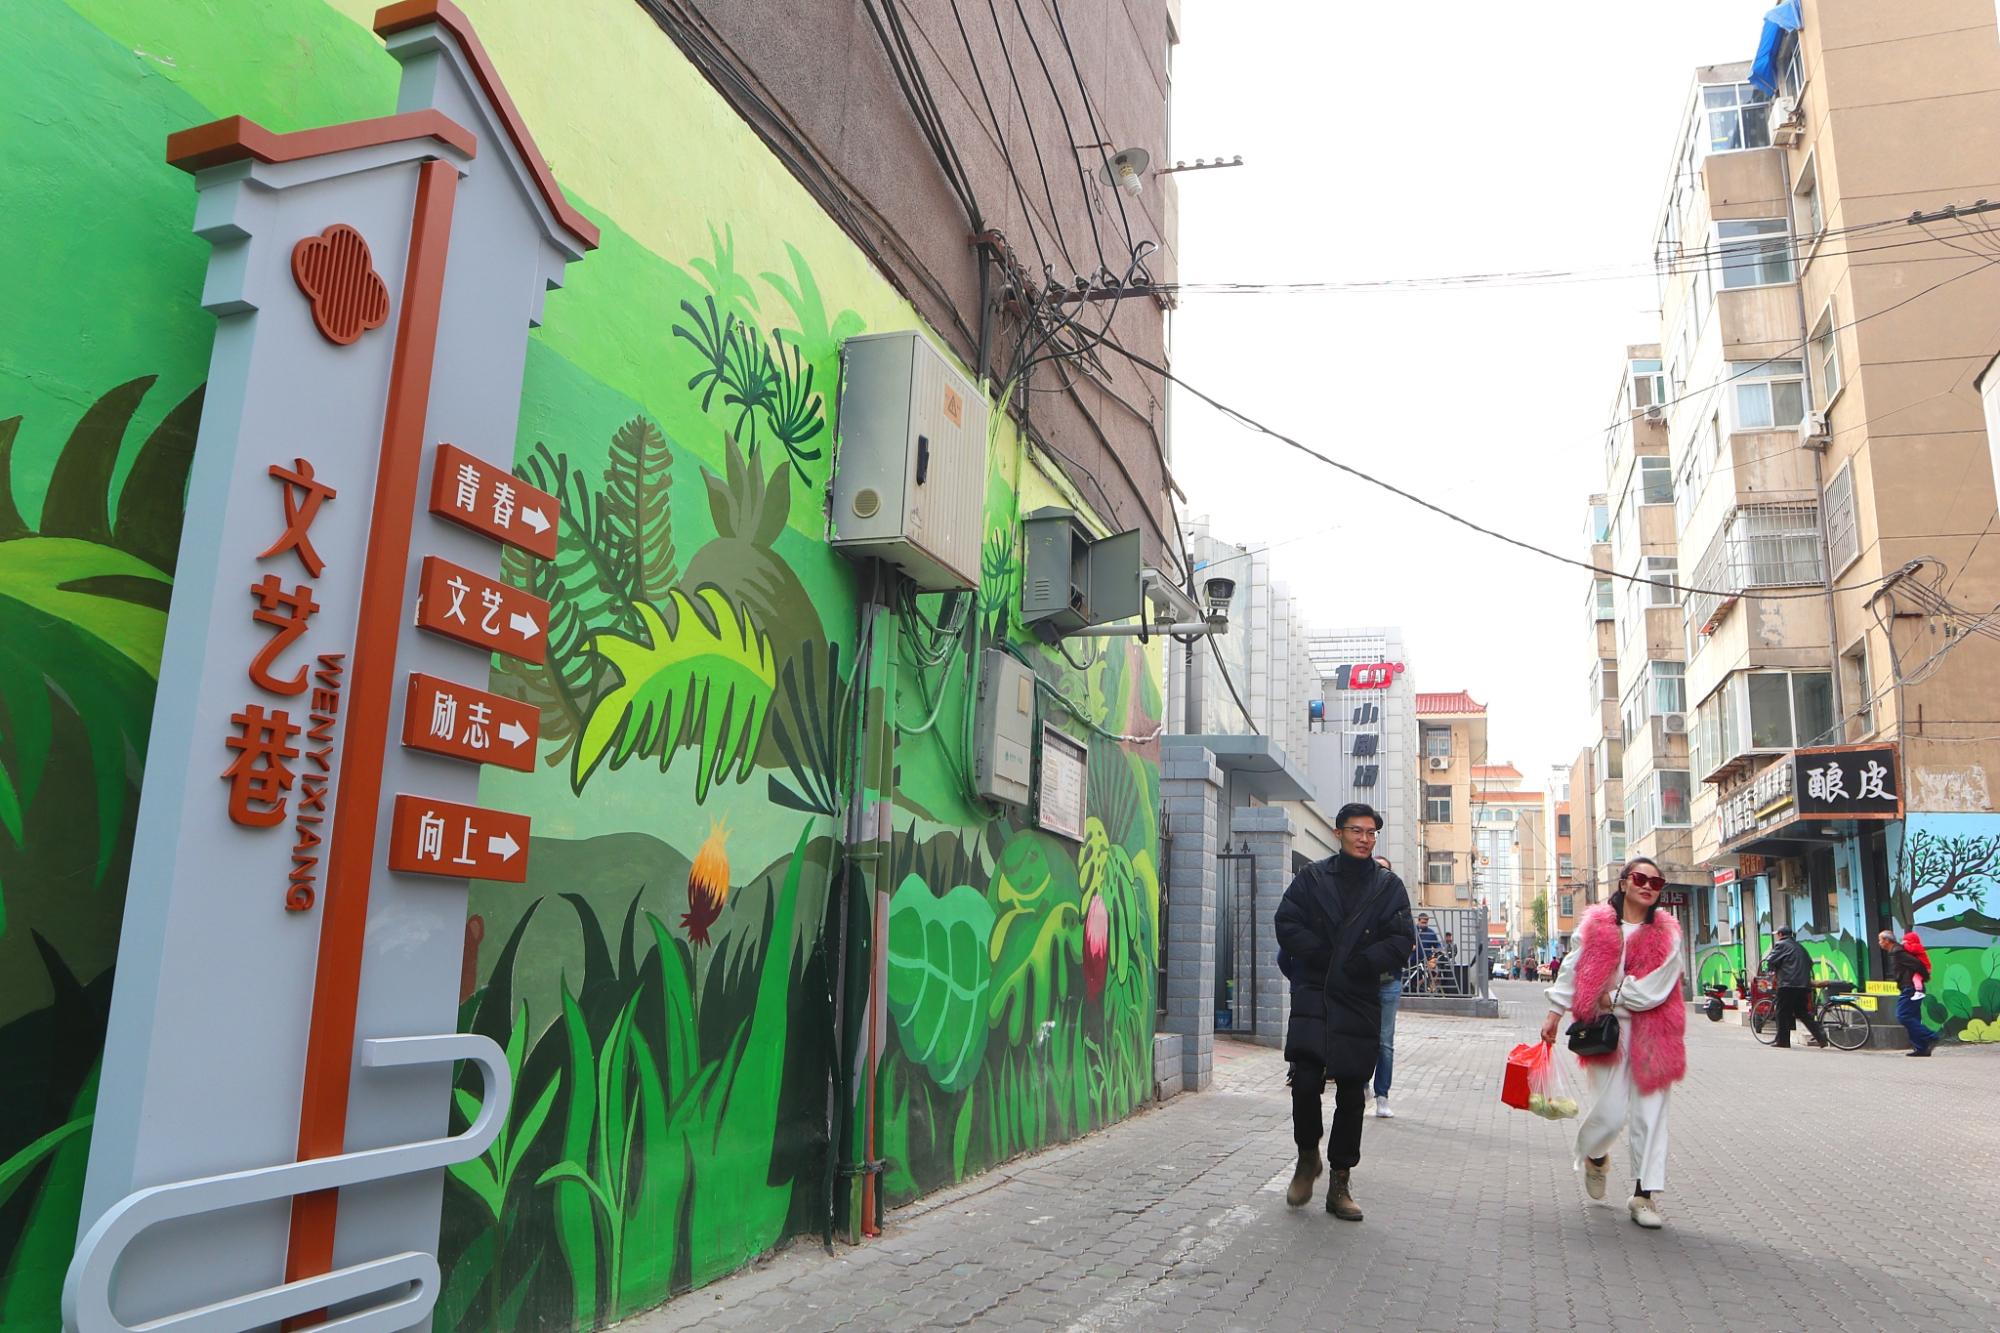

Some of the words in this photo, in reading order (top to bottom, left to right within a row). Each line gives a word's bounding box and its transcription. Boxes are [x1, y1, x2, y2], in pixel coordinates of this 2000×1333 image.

[456, 464, 516, 528] 青春
[443, 576, 503, 635] 文艺
[221, 458, 337, 827] 文艺巷
[430, 690, 492, 749] 励志
[1352, 702, 1379, 787] 小剧场
[285, 654, 346, 912] WENYIXIANG
[1807, 760, 1898, 803] 酿皮
[417, 811, 478, 865] 向上
